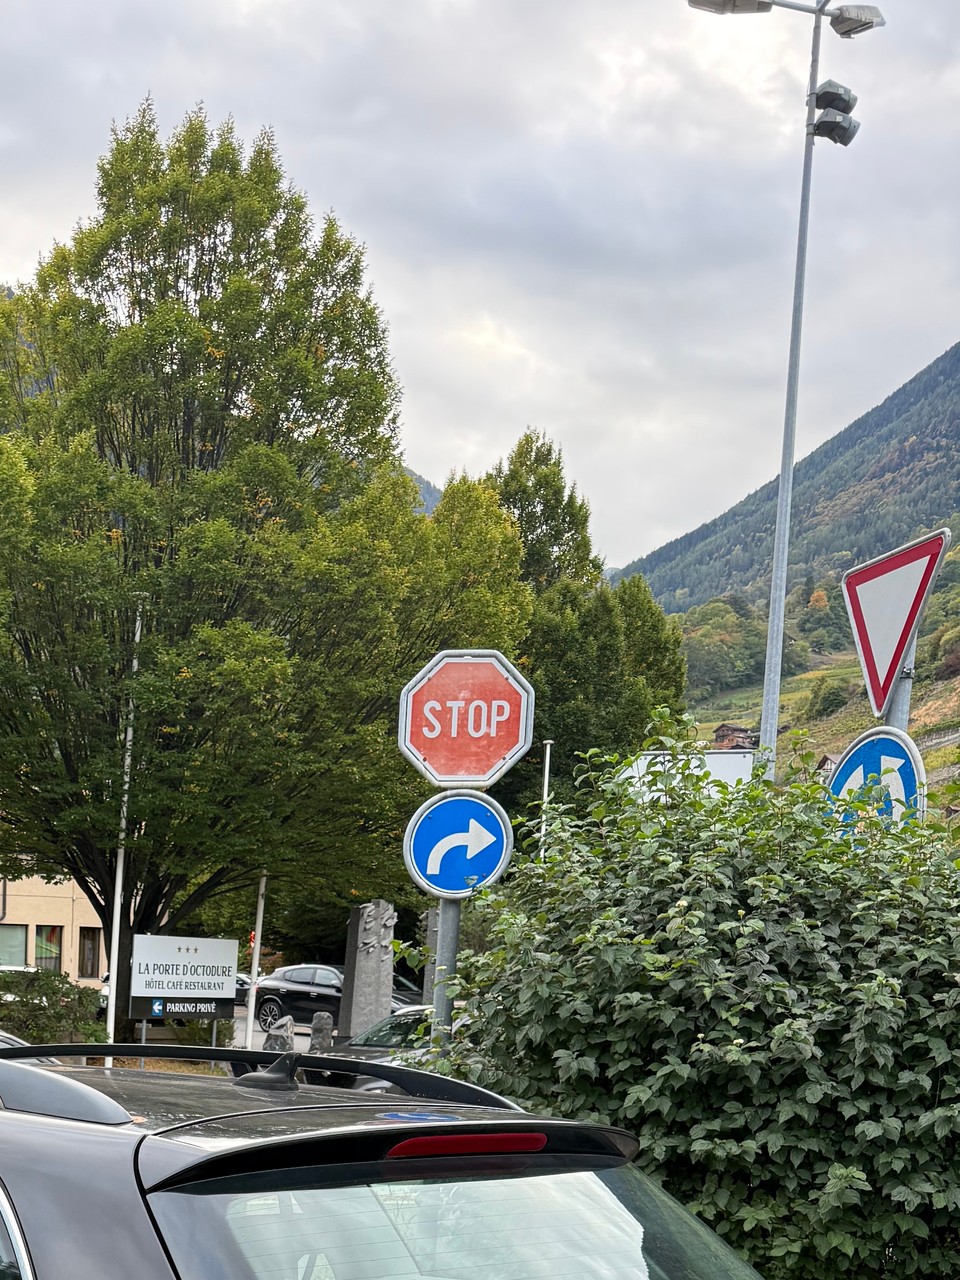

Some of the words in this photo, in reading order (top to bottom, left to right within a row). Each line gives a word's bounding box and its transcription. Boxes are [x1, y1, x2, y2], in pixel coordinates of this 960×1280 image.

[422, 699, 511, 739] STOP
[138, 962, 150, 975] LA
[152, 963, 181, 976] PORTE
[182, 961, 233, 977] D'OCTODURE
[144, 978, 166, 990] HÔTEL
[167, 979, 183, 990] CAFÉ
[184, 981, 225, 991] RESTAURANT
[166, 1002, 195, 1013] PARKING
[196, 1001, 217, 1013] PRIVÉ
